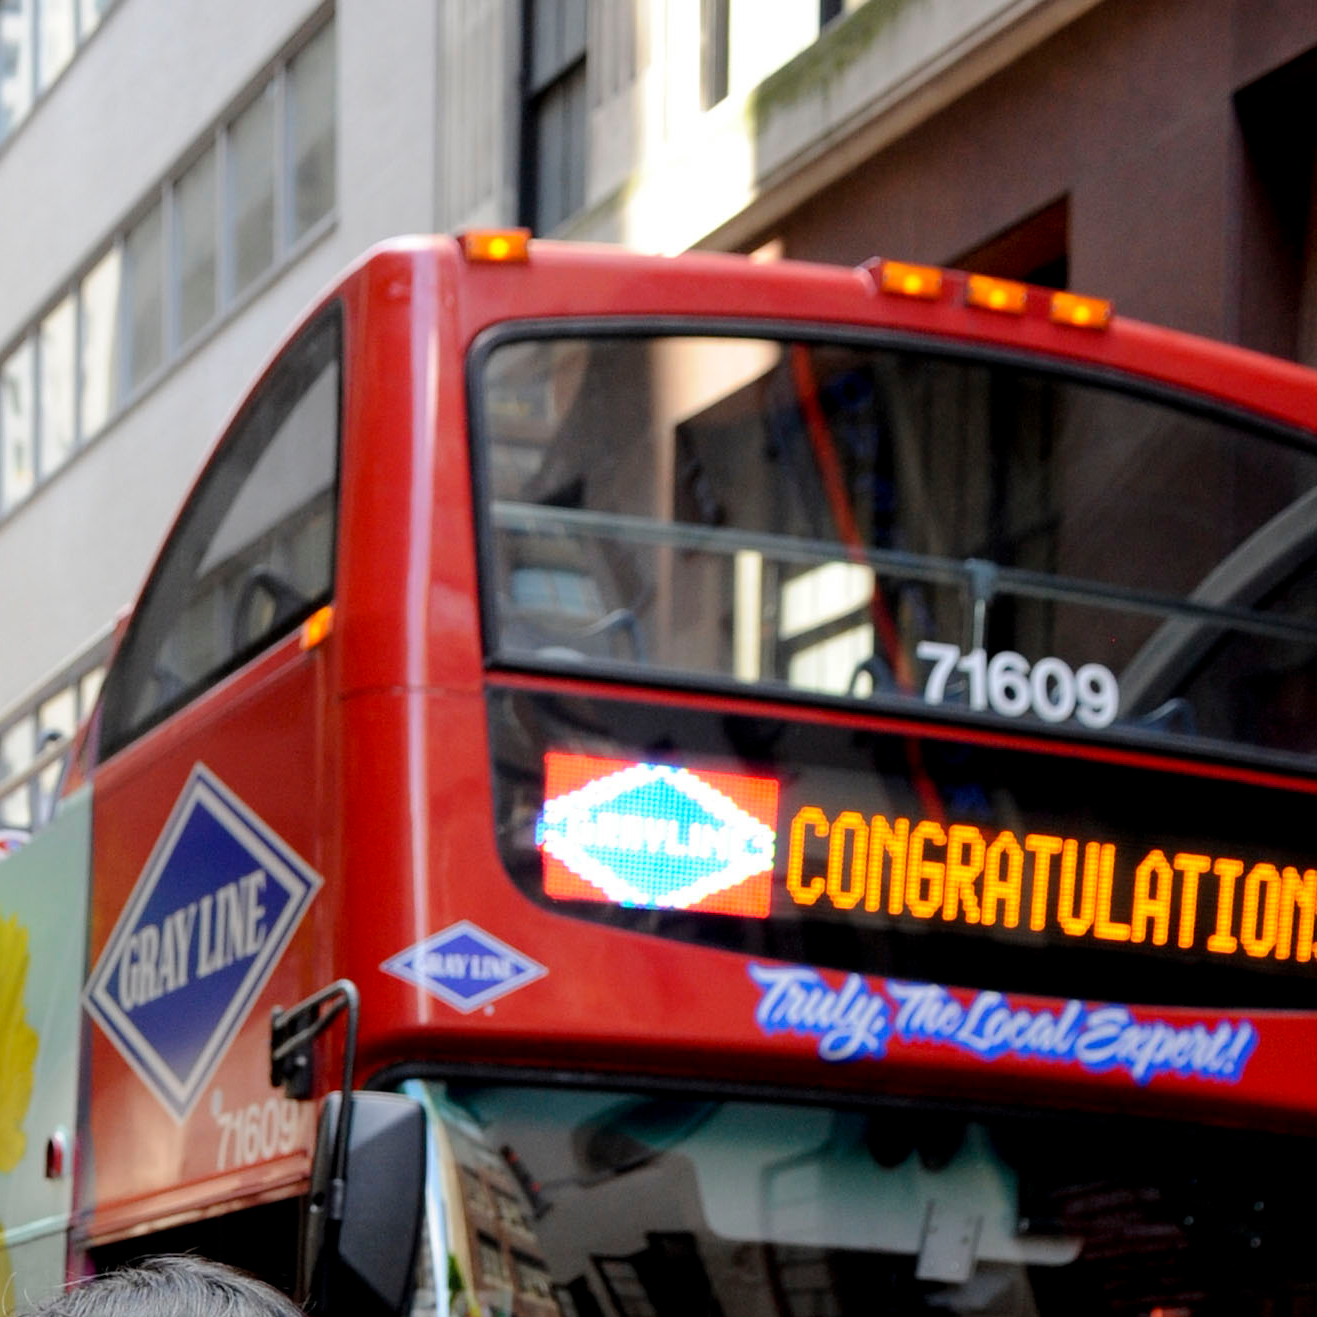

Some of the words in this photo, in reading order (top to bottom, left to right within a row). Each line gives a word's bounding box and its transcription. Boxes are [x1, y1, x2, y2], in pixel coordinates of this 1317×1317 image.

[915, 640, 1120, 729] 71609
[118, 901, 197, 1012] GRAY
[196, 869, 267, 978] LINE
[785, 806, 1317, 962] CONGRATULATION
[748, 962, 886, 1061] Truly,
[886, 982, 964, 1036] The
[957, 990, 1083, 1051] Local
[1075, 1003, 1255, 1081] Expert!
[216, 1096, 299, 1171] 71609
